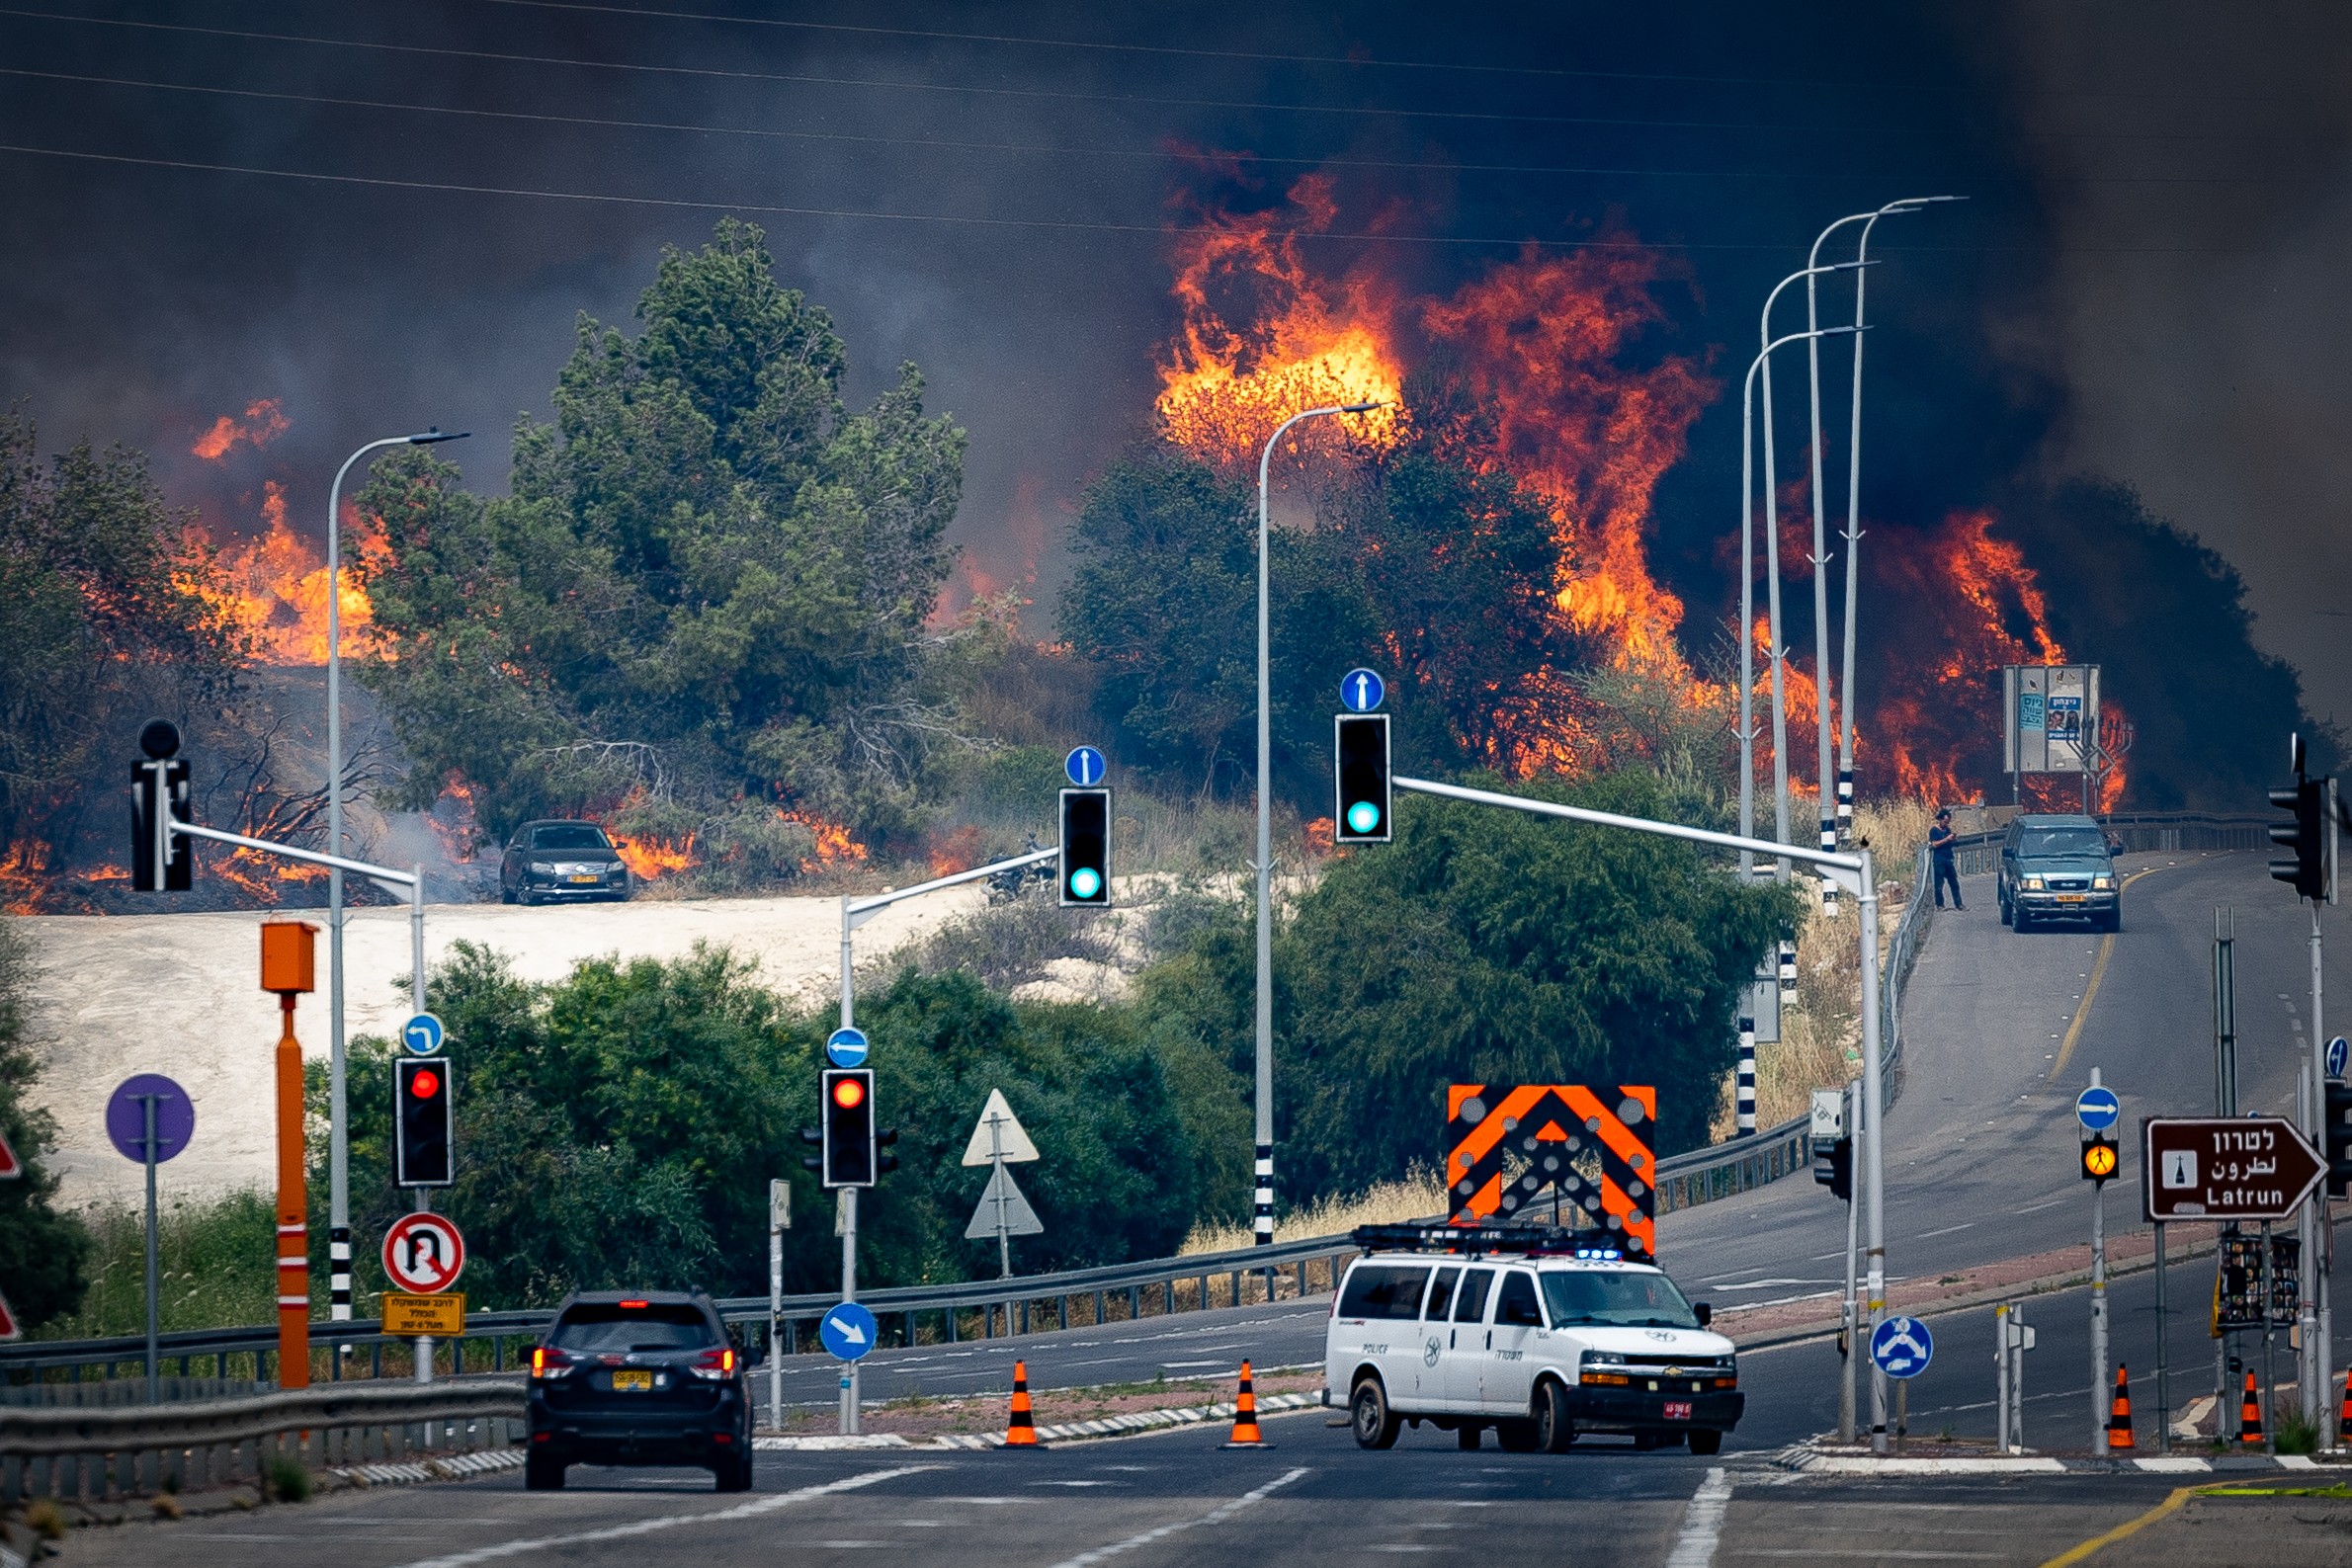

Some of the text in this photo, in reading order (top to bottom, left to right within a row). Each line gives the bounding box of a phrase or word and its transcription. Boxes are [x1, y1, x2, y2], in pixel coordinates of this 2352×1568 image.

[2213, 1128, 2275, 1154] לטרון
[2211, 1156, 2276, 1181] لطرون
[2207, 1187, 2283, 1205] Latrun
[1362, 1343, 1388, 1354] POLICE
[1494, 1349, 1523, 1362] משטרה
